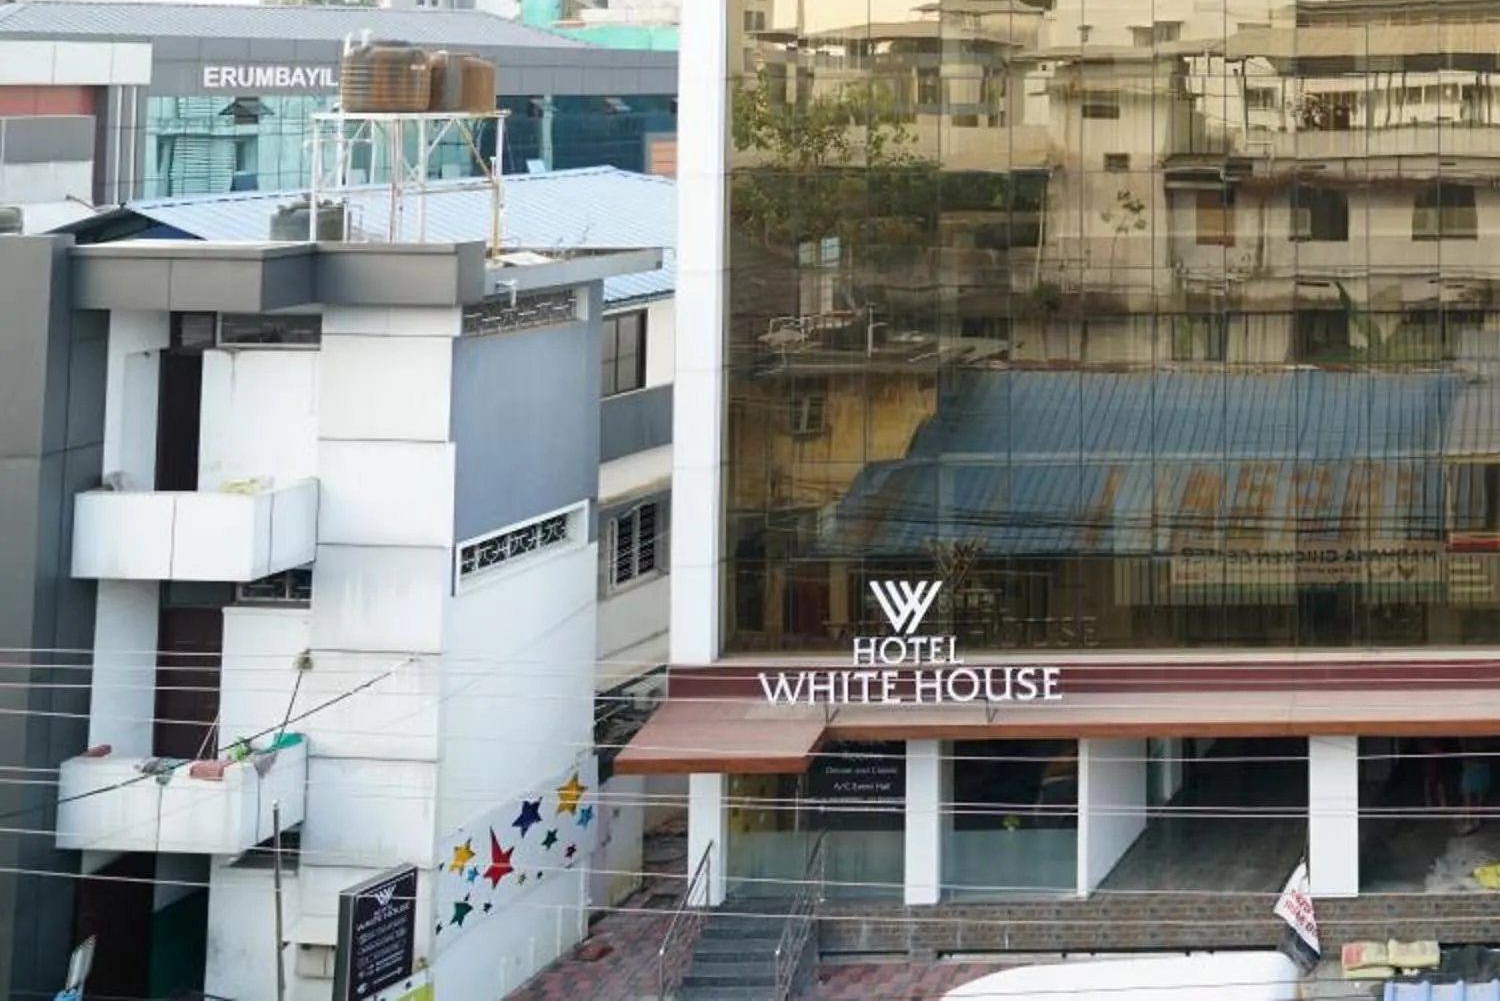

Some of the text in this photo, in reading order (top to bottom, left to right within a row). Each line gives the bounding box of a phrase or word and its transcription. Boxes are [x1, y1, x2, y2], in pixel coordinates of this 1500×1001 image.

[203, 65, 339, 88] ERUMBAYIL
[852, 636, 964, 666] HOTEL
[757, 667, 1063, 706] WHITE HOUSE
